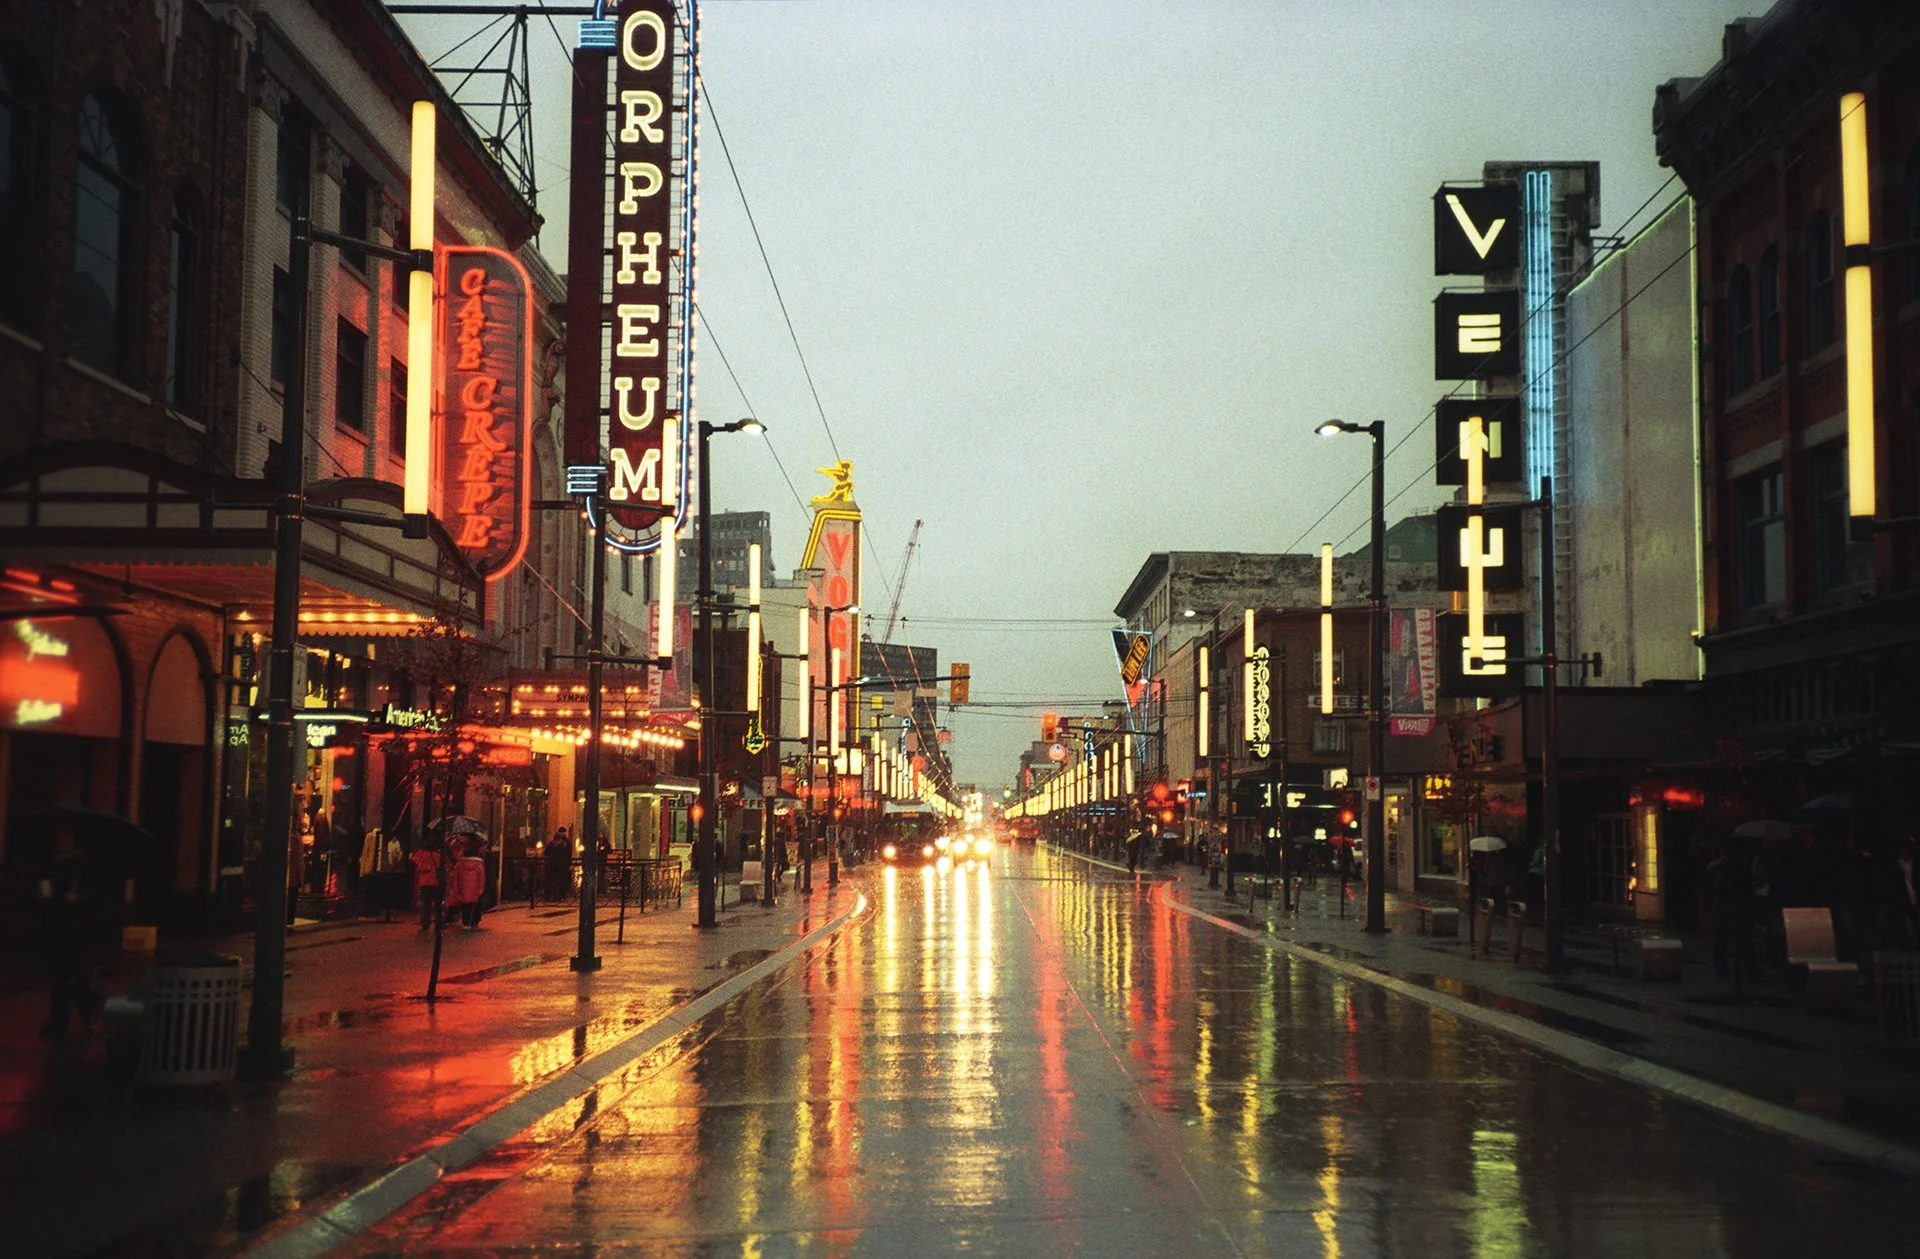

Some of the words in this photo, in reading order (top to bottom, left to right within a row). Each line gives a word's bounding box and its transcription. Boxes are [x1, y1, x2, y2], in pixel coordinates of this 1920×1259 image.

[609, 9, 666, 501] ORPHEUM
[1445, 194, 1507, 676] VENUE
[827, 531, 852, 730] VOG
